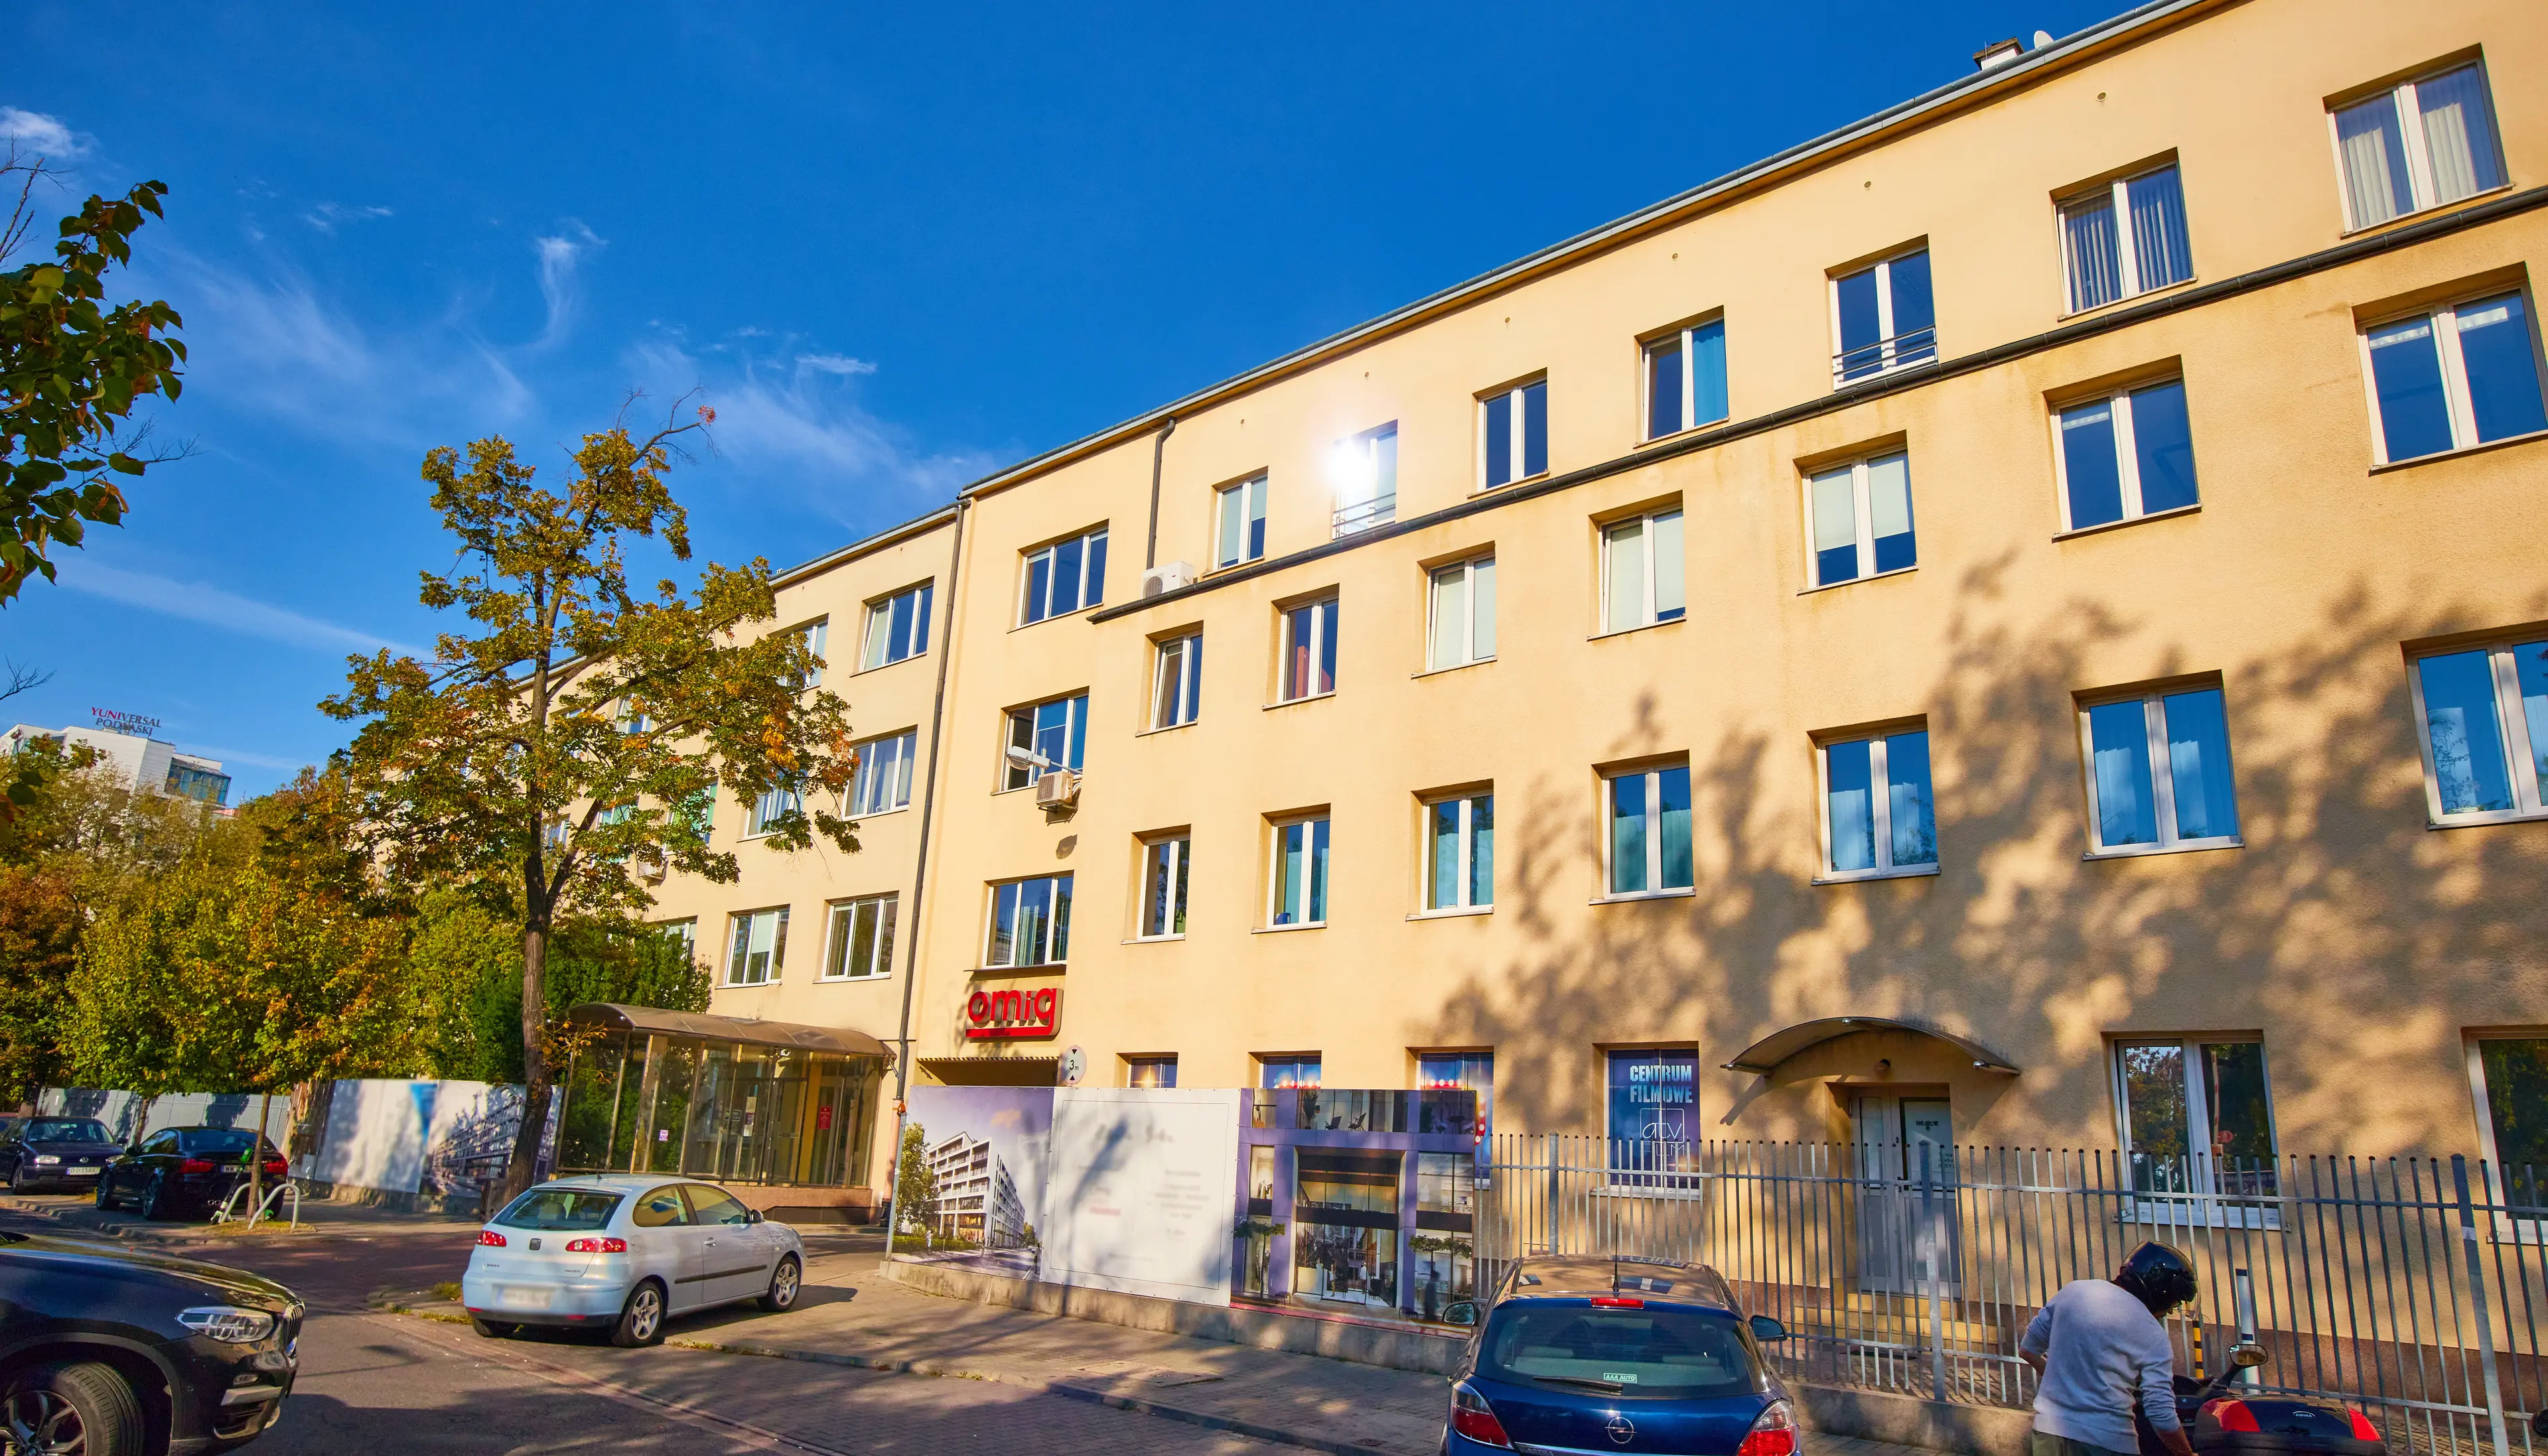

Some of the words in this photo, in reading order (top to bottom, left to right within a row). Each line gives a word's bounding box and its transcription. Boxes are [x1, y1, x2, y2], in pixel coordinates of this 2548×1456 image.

[92, 706, 161, 727] YUNIVERSAL
[966, 988, 1059, 1038] omig
[1630, 1065, 1692, 1082] CENTRUM
[1630, 1085, 1693, 1103] FILMOWE
